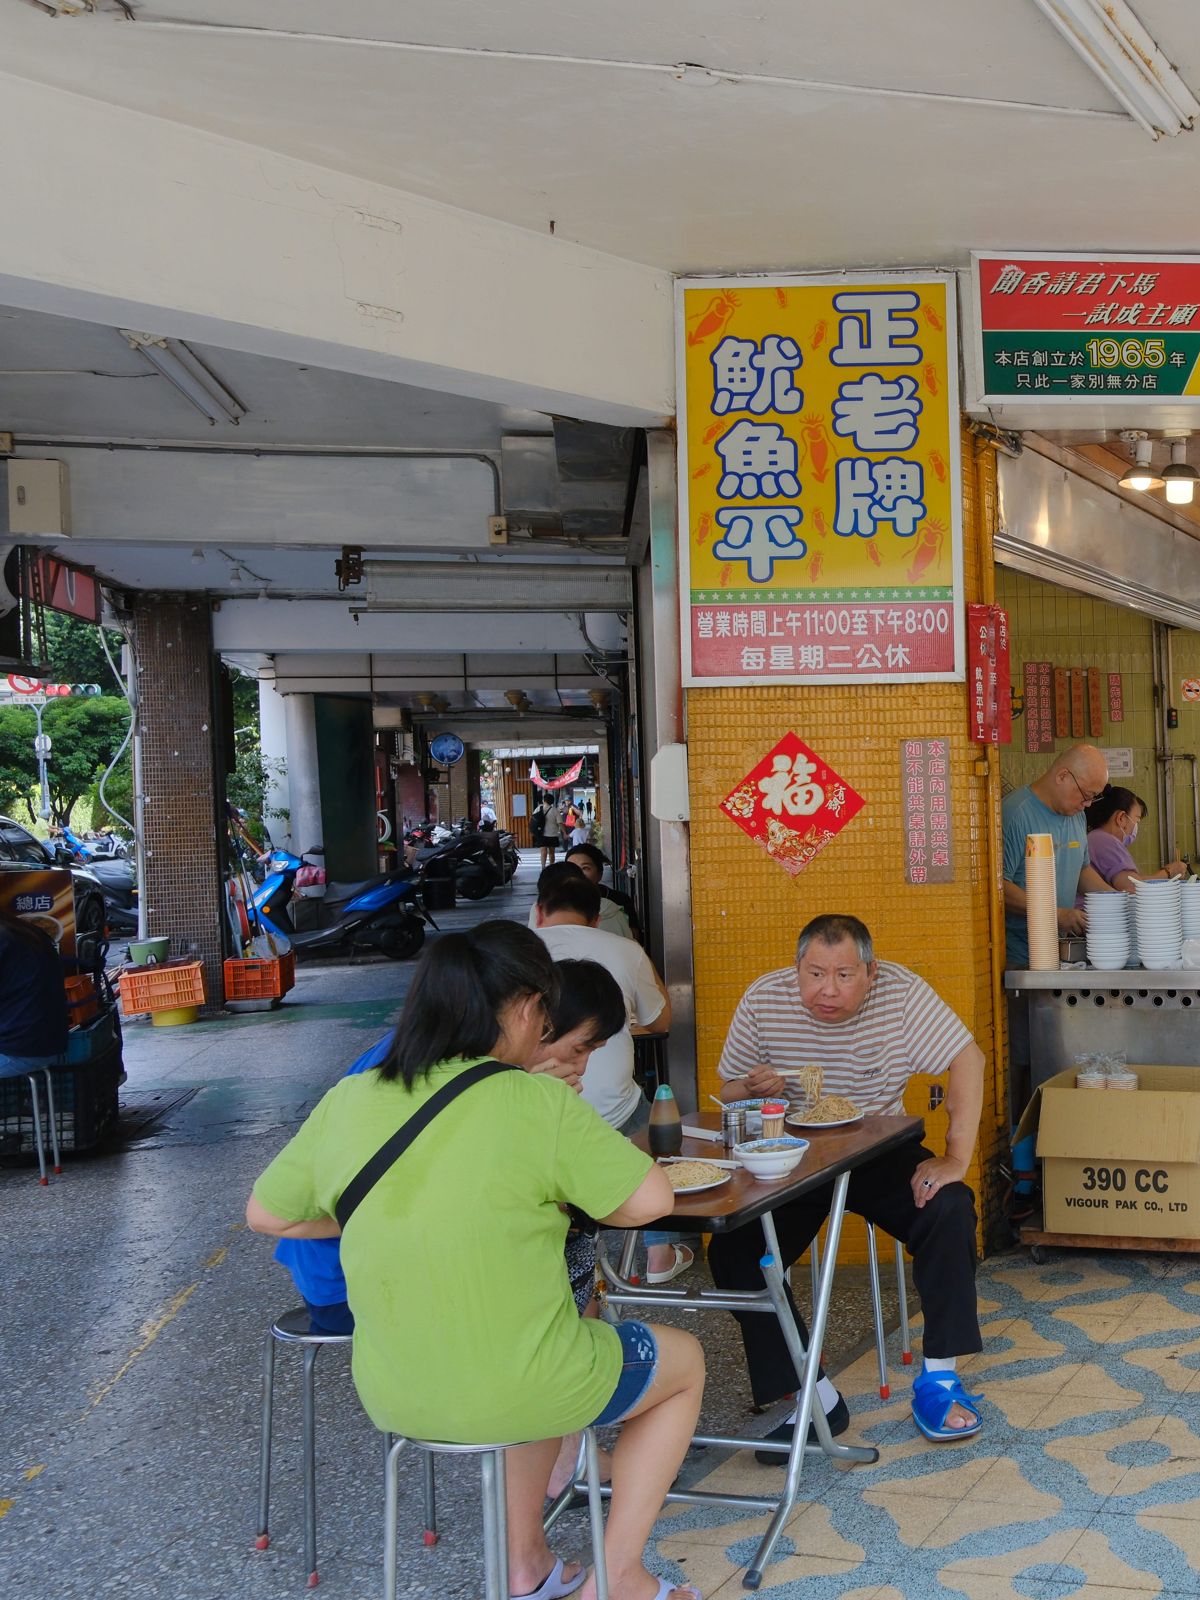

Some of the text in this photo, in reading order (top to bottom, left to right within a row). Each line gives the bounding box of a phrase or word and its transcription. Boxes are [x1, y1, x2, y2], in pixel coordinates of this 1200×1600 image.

[990, 271, 1160, 295] 聞香請君下馬
[1062, 303, 1200, 326] 一試成主顧
[1016, 374, 1158, 390] 只此一家別無分店
[829, 291, 927, 537] 正老牌
[710, 334, 807, 583] 魷魚平
[697, 608, 949, 638] 營業時間上午11:00至下午8:00
[740, 644, 911, 671] 每星期二公休
[758, 753, 824, 816] 福
[905, 742, 927, 883] 如不能共桌請外帶
[928, 741, 949, 866] 本店內用需共桌
[16, 896, 51, 910] 總店
[1082, 1166, 1169, 1194] 390 CC
[1065, 1197, 1109, 1209] VIGOUR
[1115, 1200, 1138, 1210] PAK
[1168, 1202, 1188, 1212] LTD
